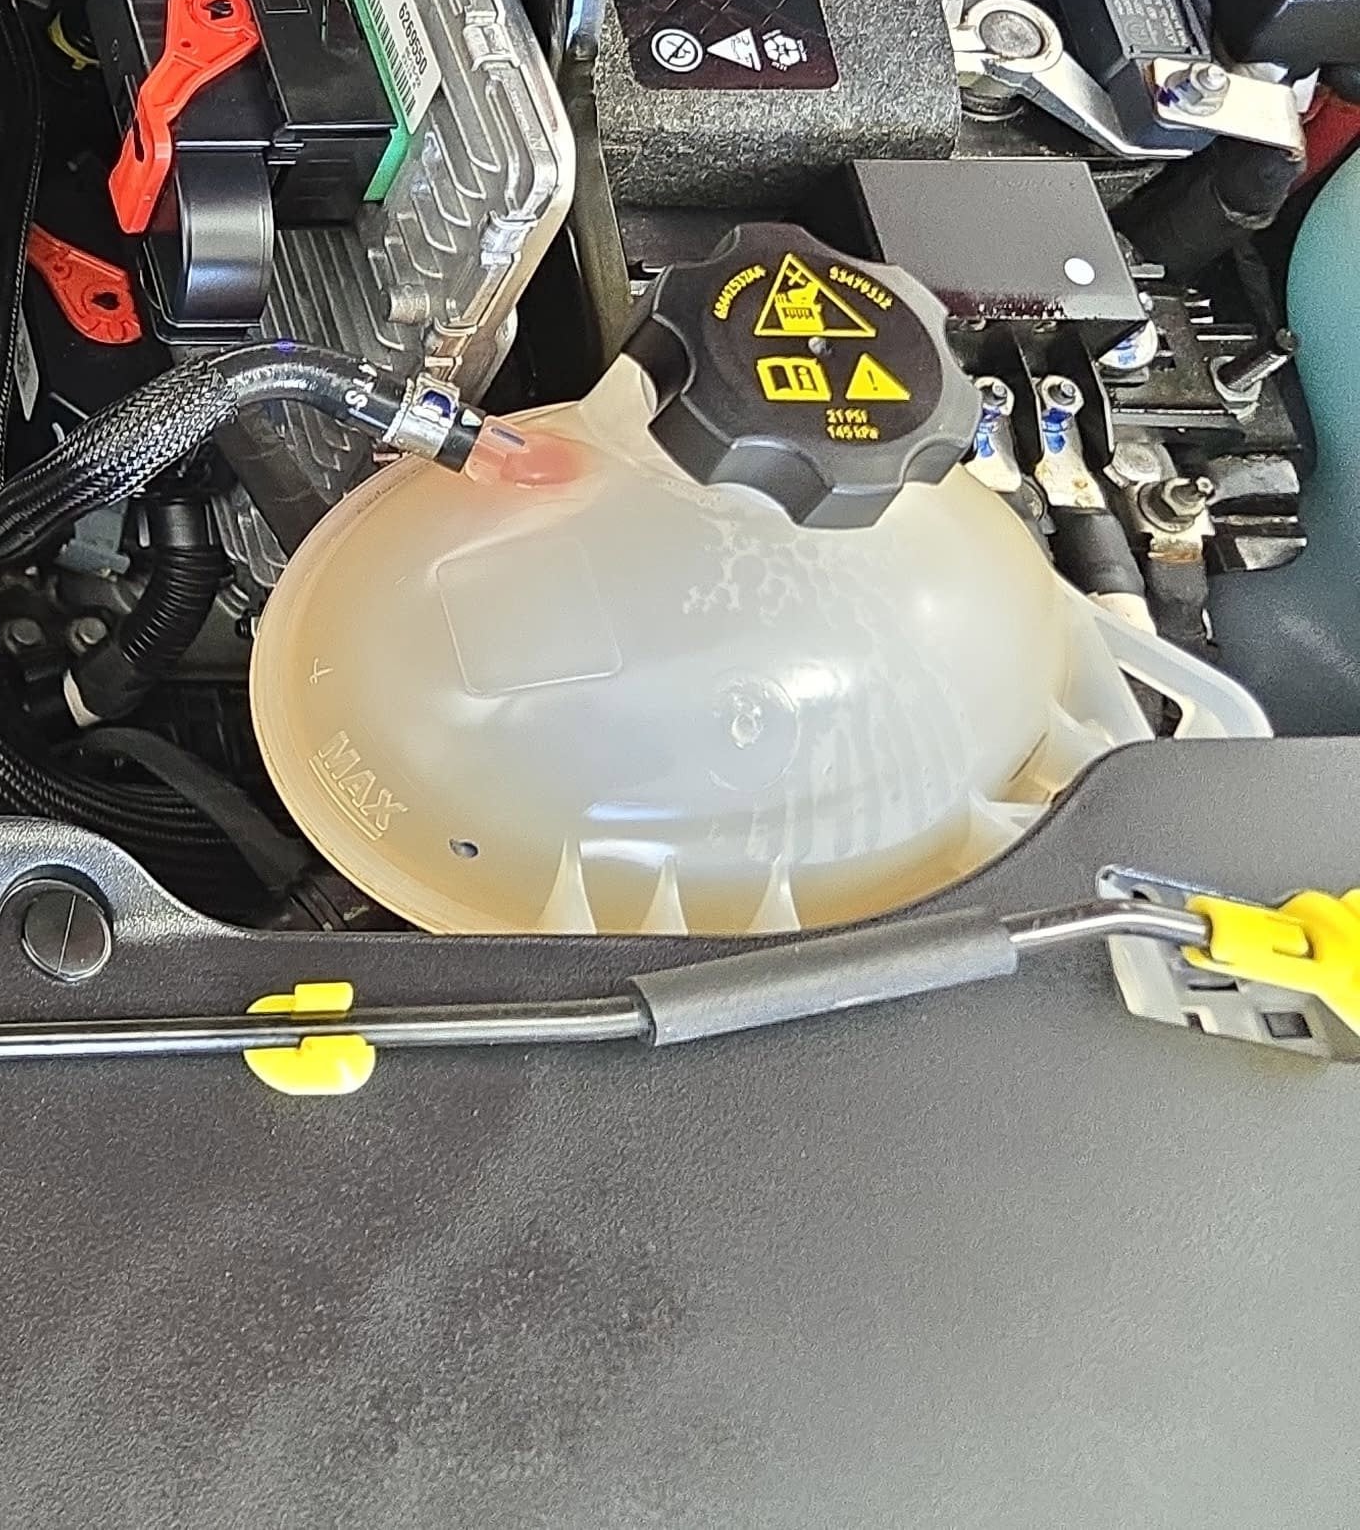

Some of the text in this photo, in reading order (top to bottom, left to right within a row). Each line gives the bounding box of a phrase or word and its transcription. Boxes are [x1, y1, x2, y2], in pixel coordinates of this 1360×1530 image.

[397, 1, 429, 75] 6269550
[844, 408, 868, 423] PSI
[318, 730, 409, 831] MAX
